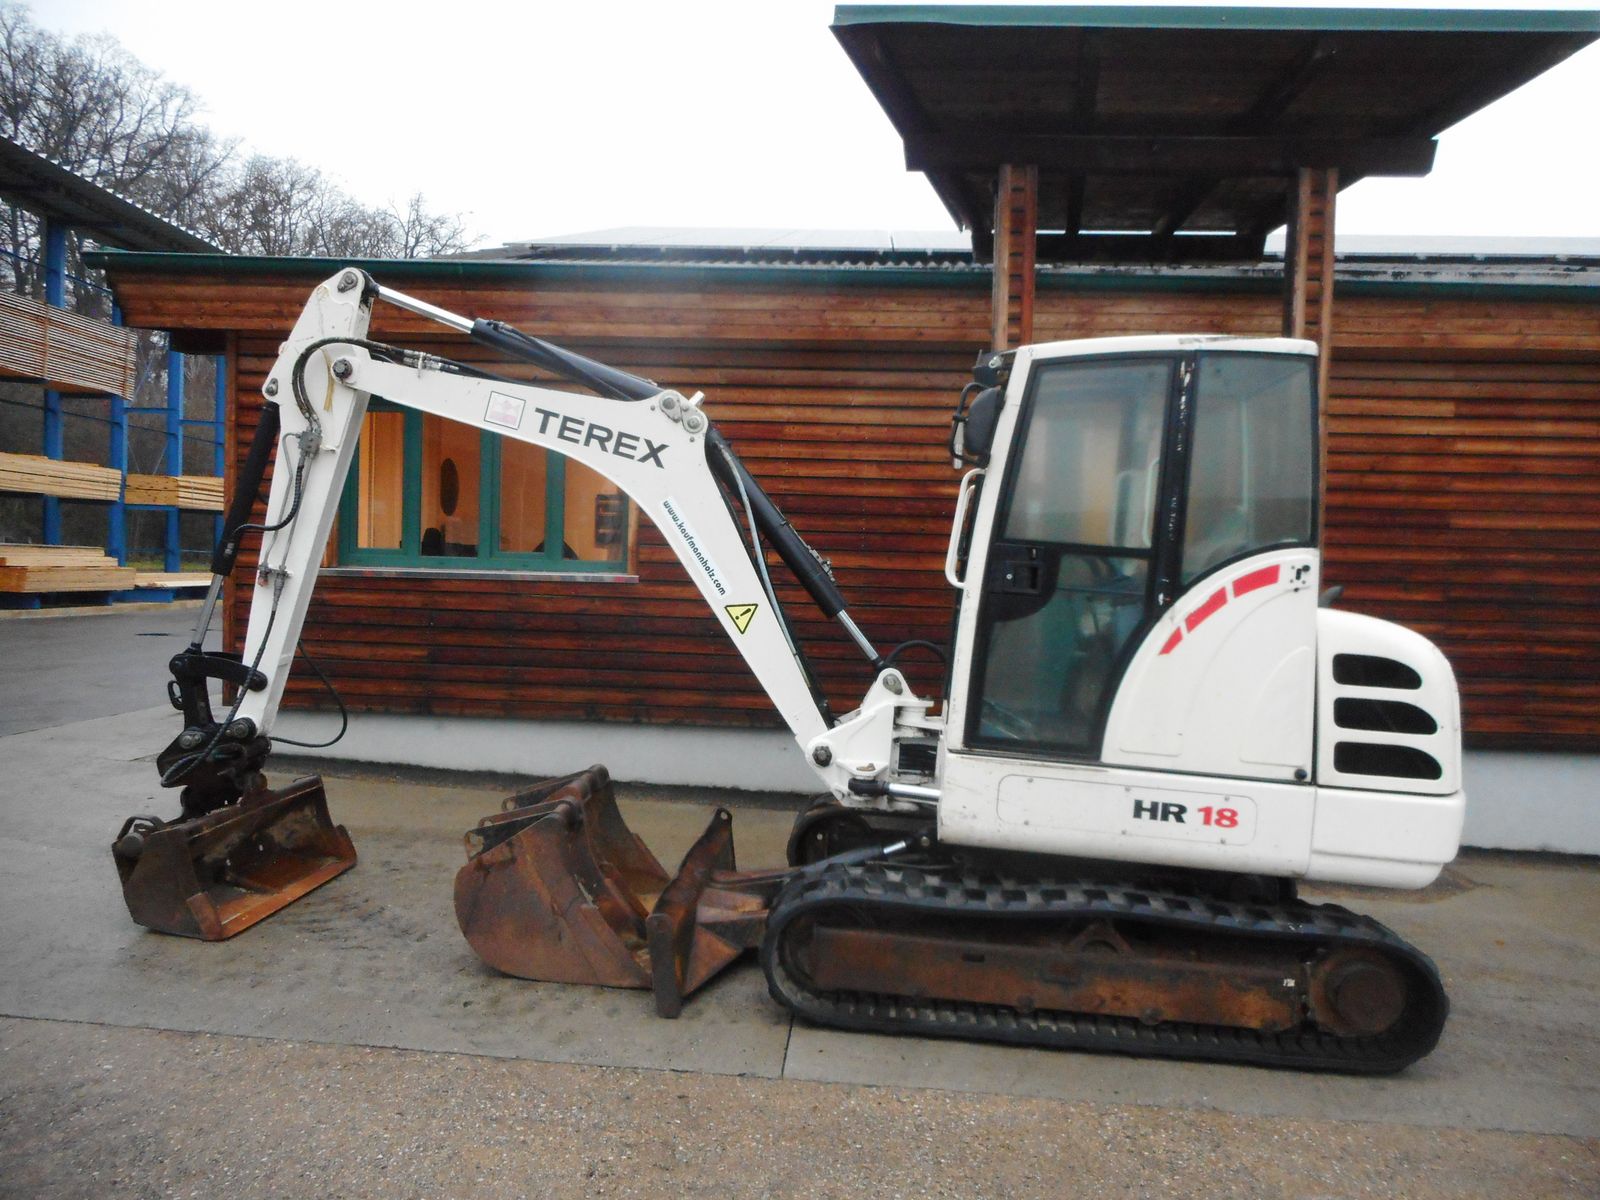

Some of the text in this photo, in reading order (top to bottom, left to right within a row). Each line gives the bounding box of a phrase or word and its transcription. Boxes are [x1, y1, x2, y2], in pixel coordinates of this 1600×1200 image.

[535, 407, 670, 469] TEREX
[663, 500, 726, 596] www.kaufmannholz.com
[1133, 799, 1239, 828] HR 18
